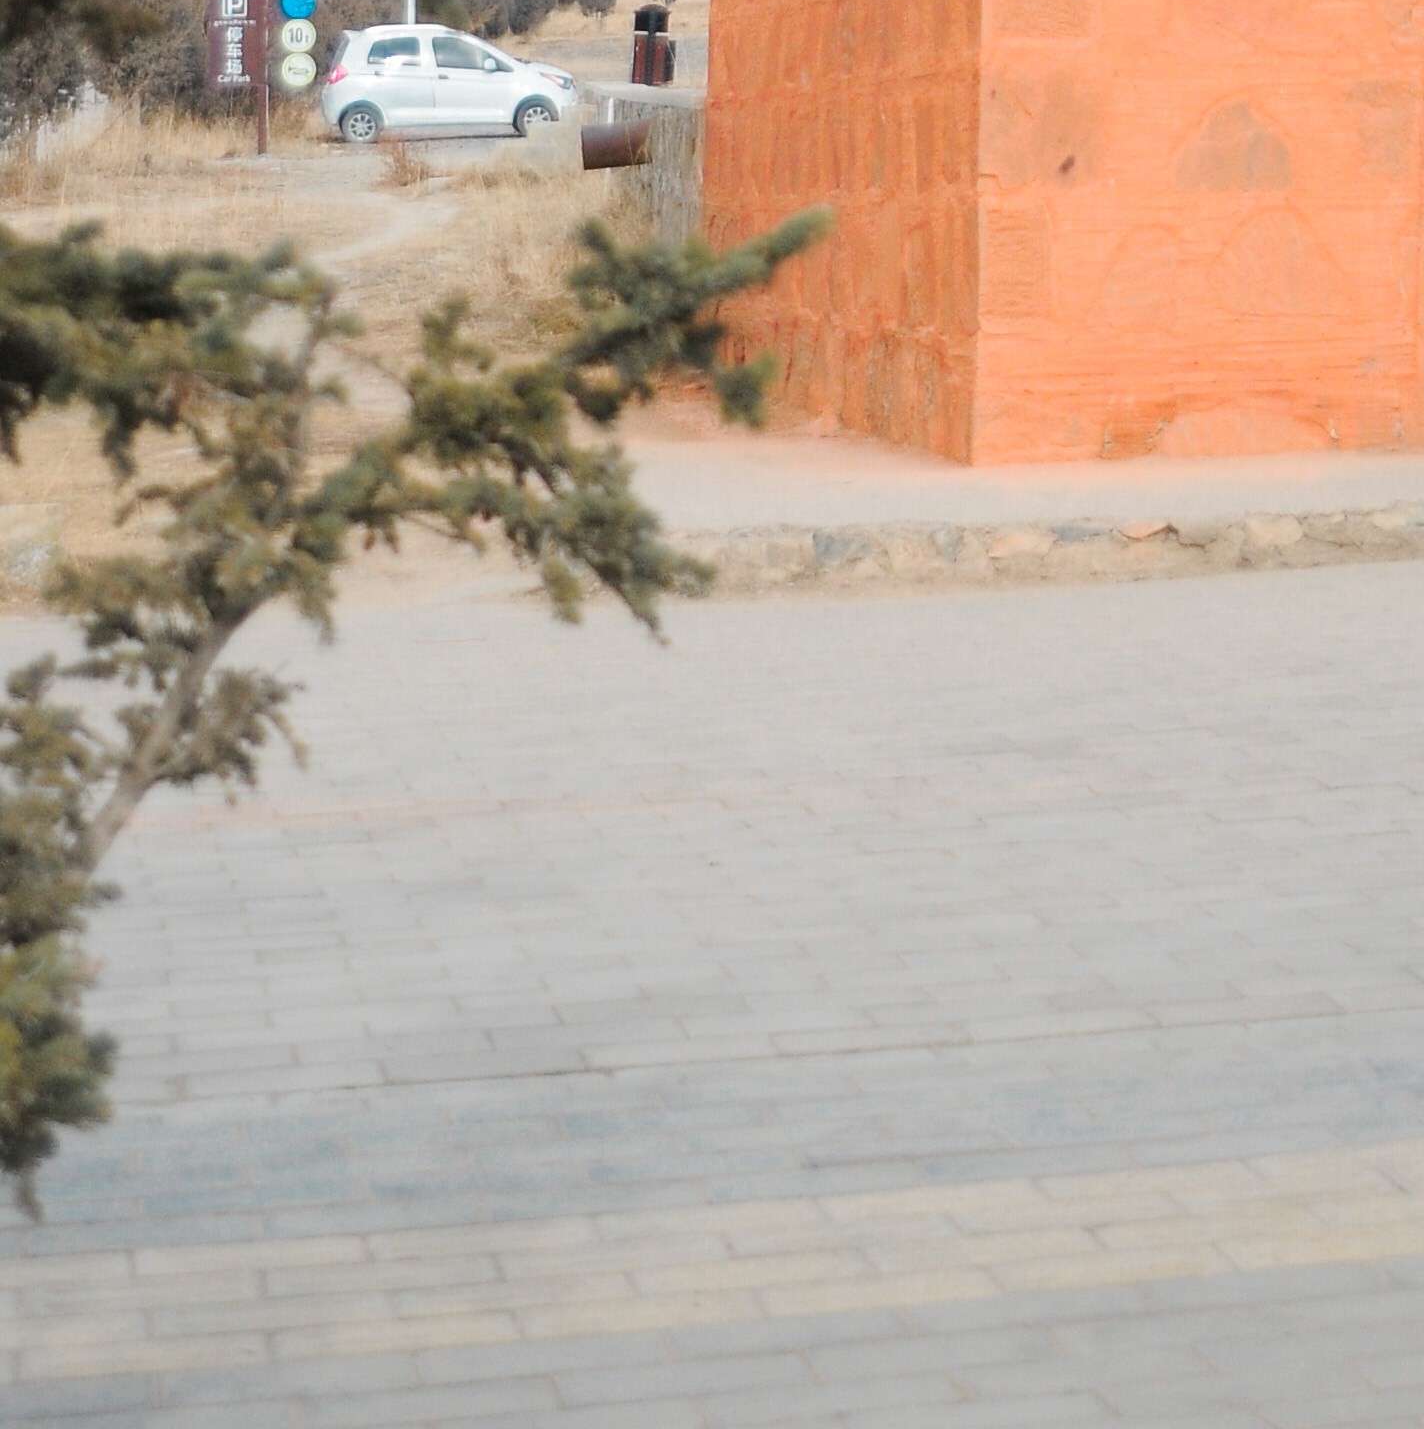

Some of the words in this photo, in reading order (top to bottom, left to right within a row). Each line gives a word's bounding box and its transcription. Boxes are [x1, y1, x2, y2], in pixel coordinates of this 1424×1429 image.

[288, 27, 303, 43] 10
[226, 26, 243, 74] 停车场
[217, 74, 231, 83] Car
[232, 74, 251, 83] Park
